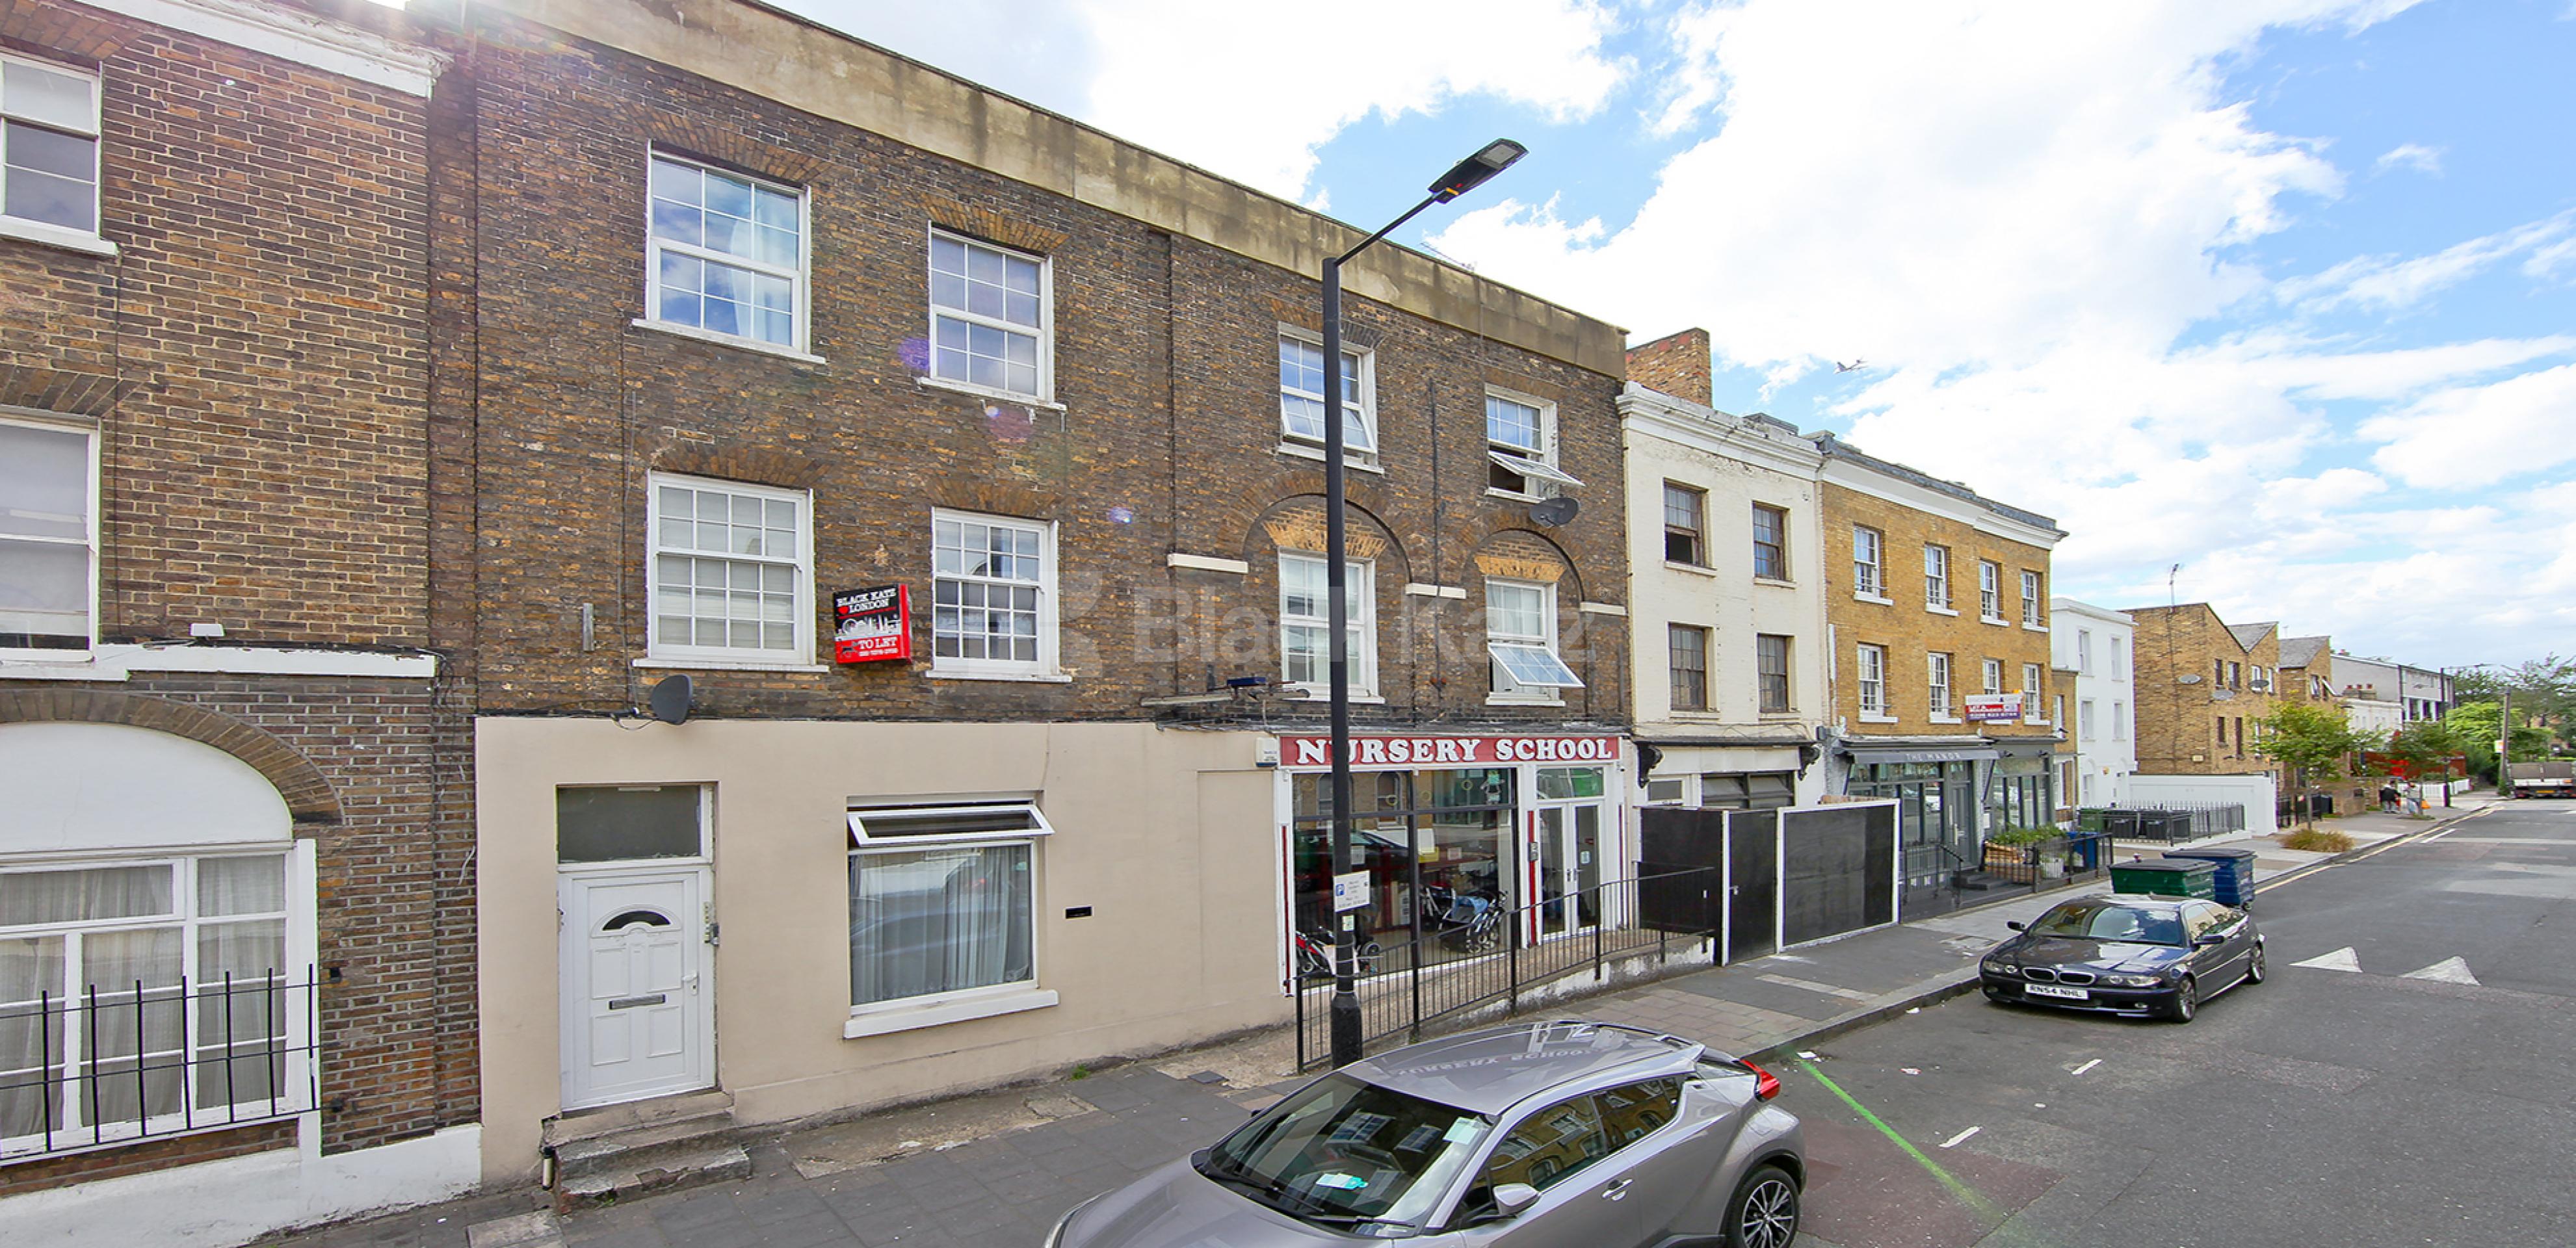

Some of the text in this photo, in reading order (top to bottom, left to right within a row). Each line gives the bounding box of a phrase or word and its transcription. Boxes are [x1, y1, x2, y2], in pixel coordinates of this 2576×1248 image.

[836, 593, 869, 607] BLACK
[848, 598, 889, 614] LONDON
[858, 637, 897, 650] TO LET
[1495, 738, 1613, 760] SCHOOL
